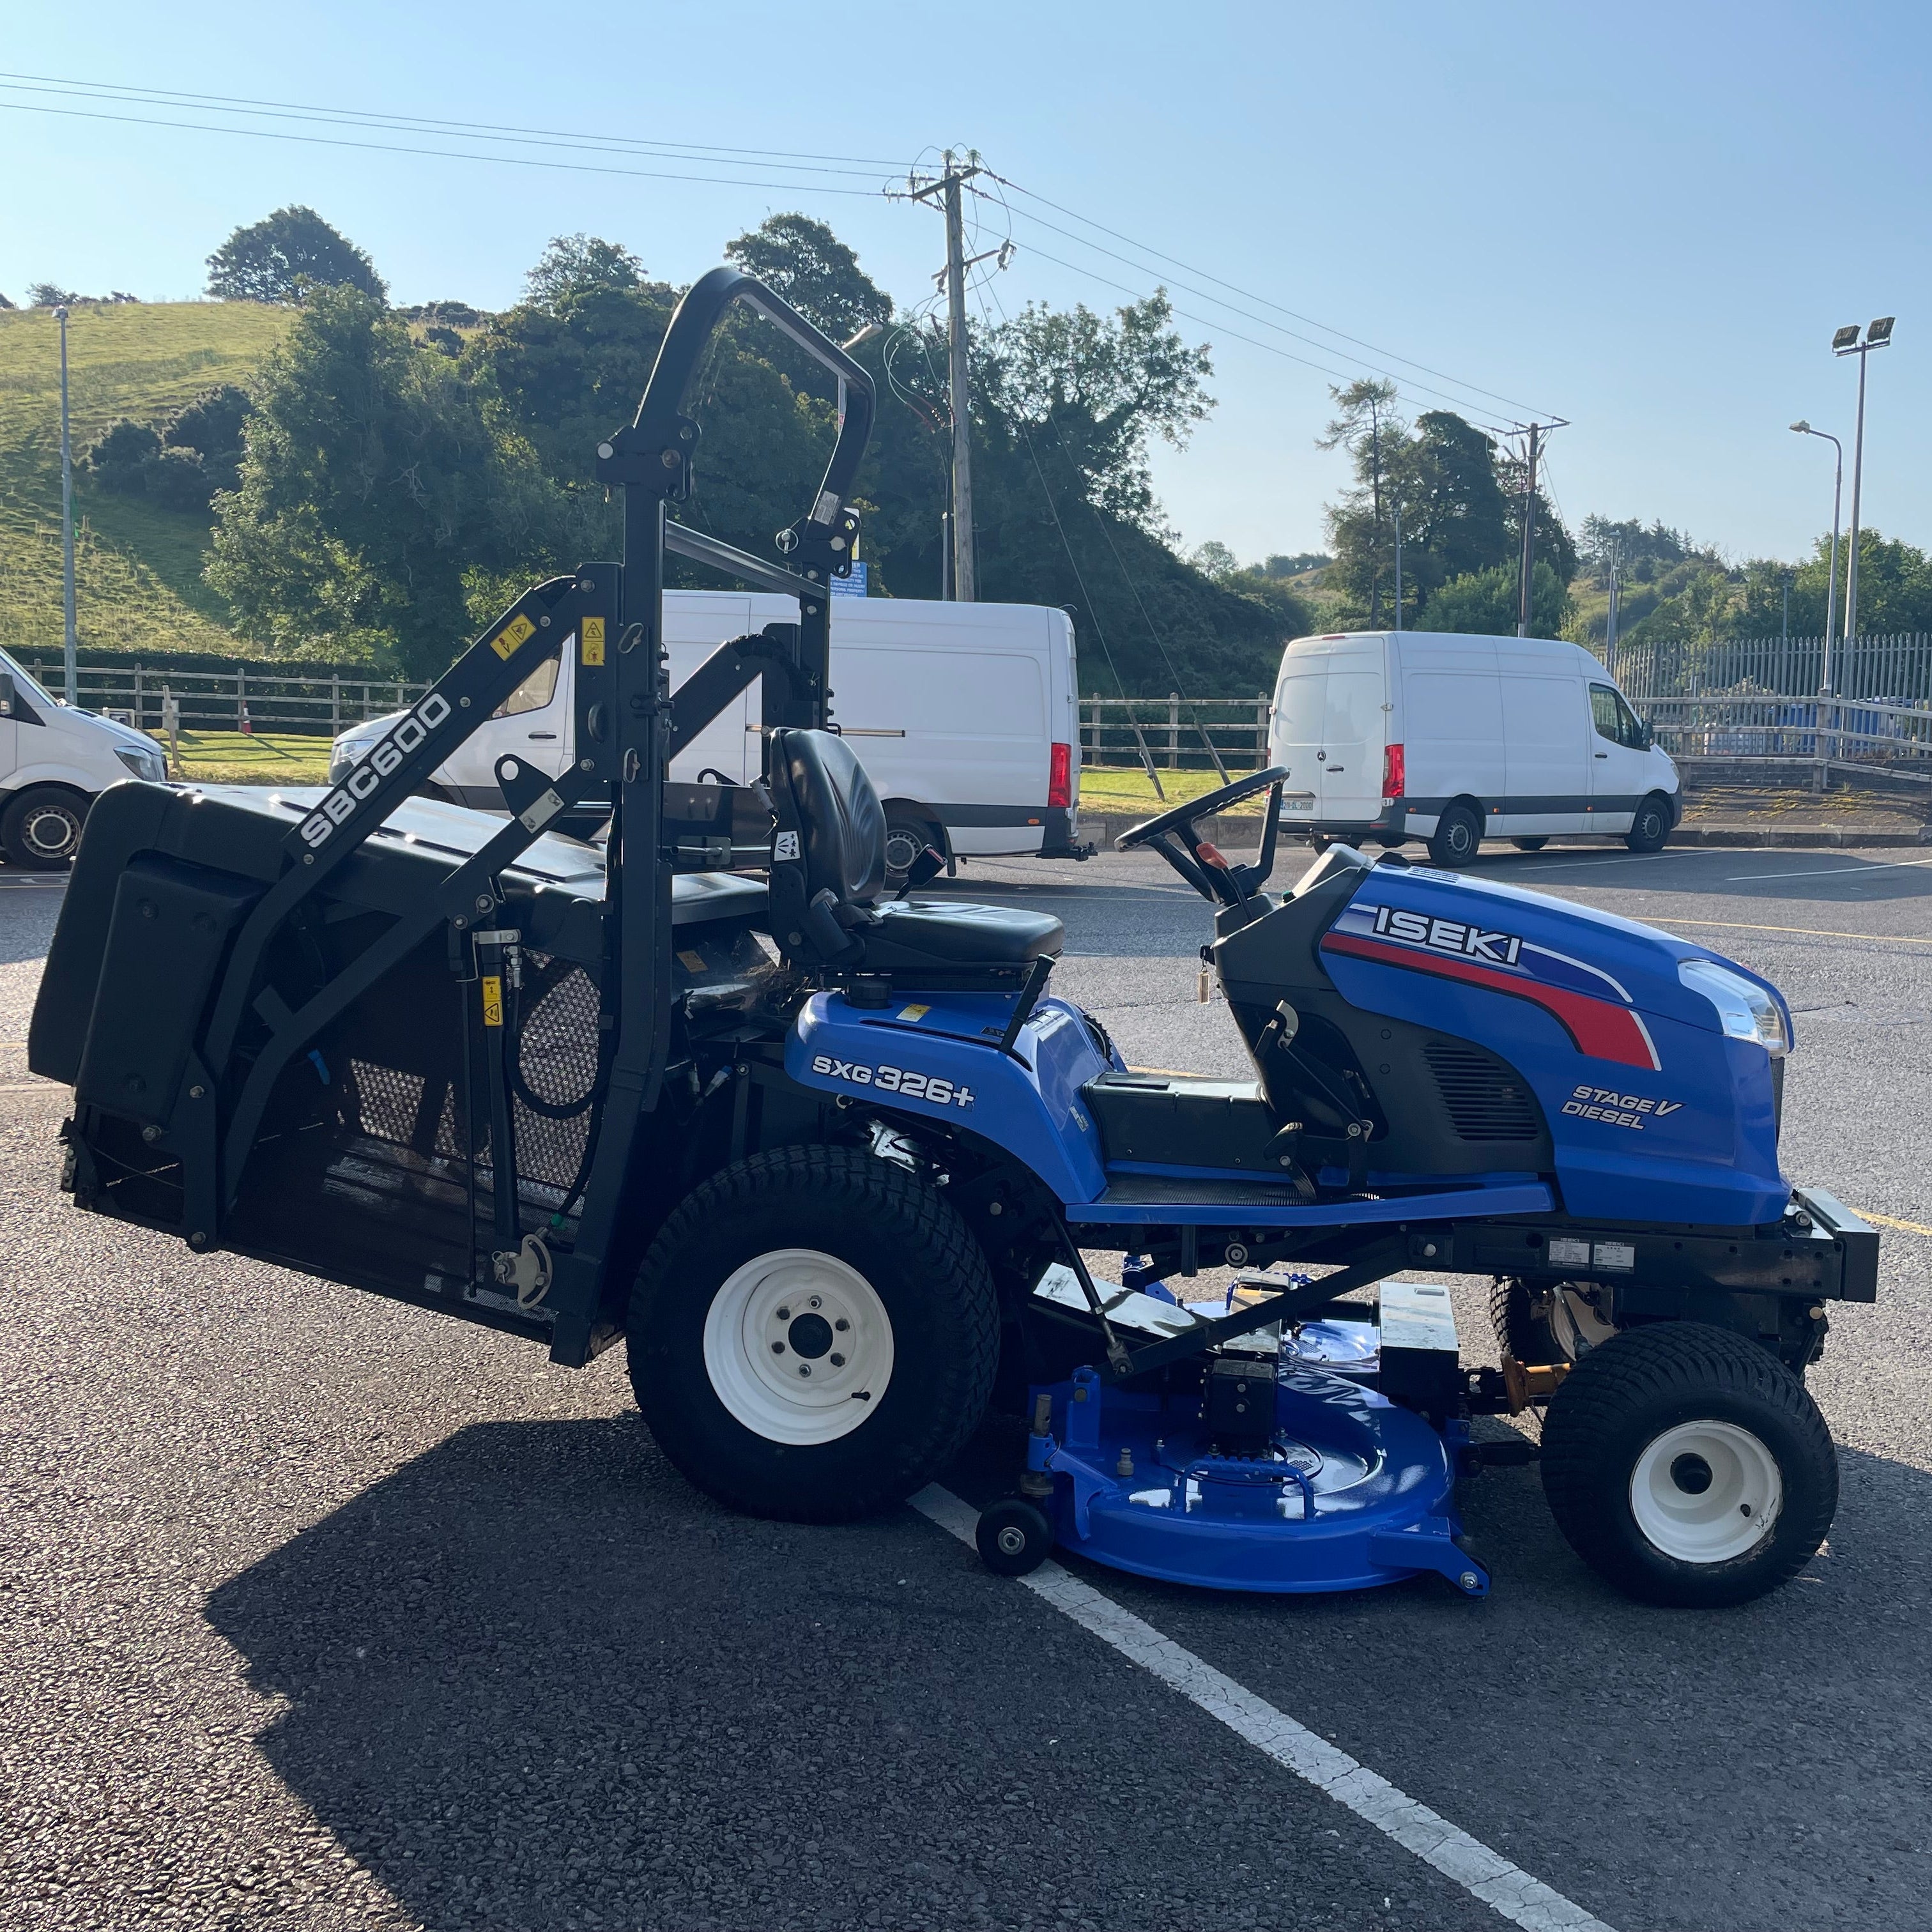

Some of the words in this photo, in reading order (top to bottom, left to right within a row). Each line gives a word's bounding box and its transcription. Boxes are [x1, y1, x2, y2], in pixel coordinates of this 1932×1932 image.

[301, 693, 451, 848] SBC600
[1374, 906, 1521, 965] ISEKI
[812, 1055, 873, 1084] SXG
[874, 1065, 975, 1107] 326+
[1572, 1085, 1656, 1114] STAGE
[1654, 1101, 1683, 1116] V
[1561, 1101, 1644, 1130] DIESEL
